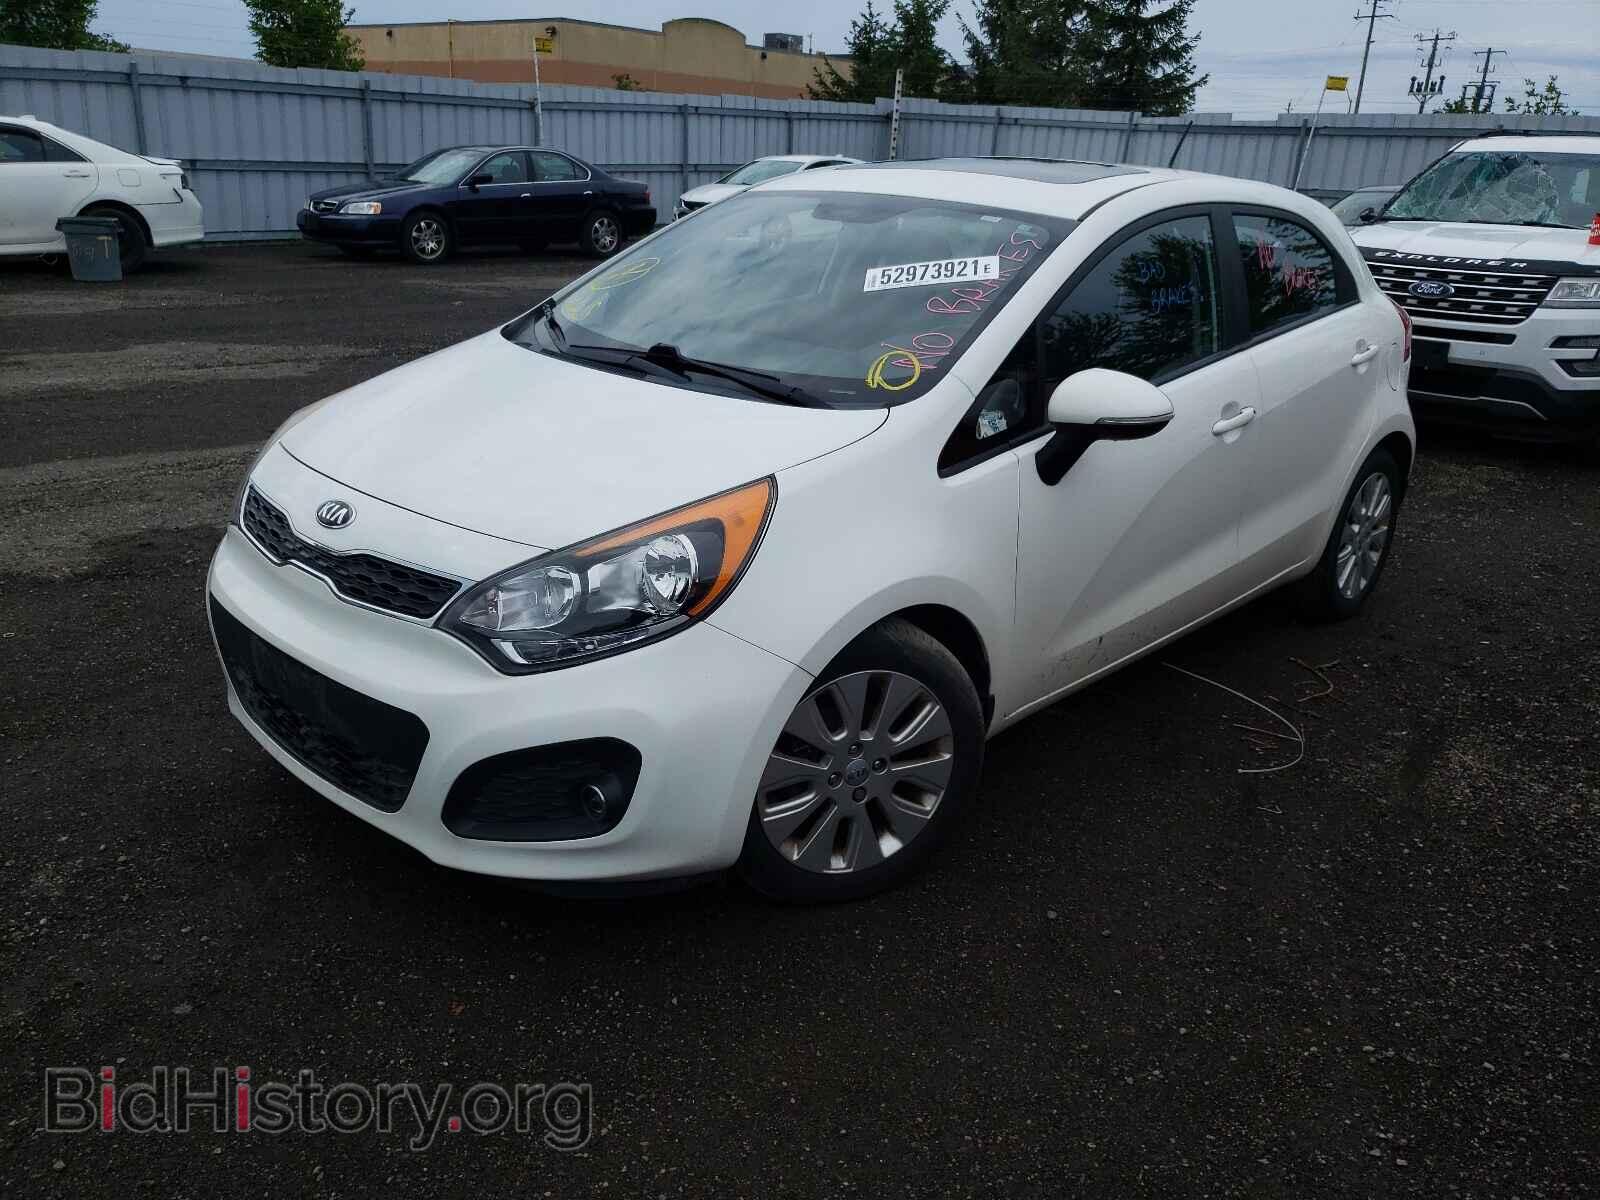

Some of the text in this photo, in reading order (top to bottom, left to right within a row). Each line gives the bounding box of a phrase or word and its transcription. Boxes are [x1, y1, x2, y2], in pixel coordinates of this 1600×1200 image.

[1375, 251, 1528, 268] EXPLORER
[880, 259, 992, 285] 52973921 E
[1417, 282, 1444, 295] Ford
[317, 502, 349, 526] KIA
